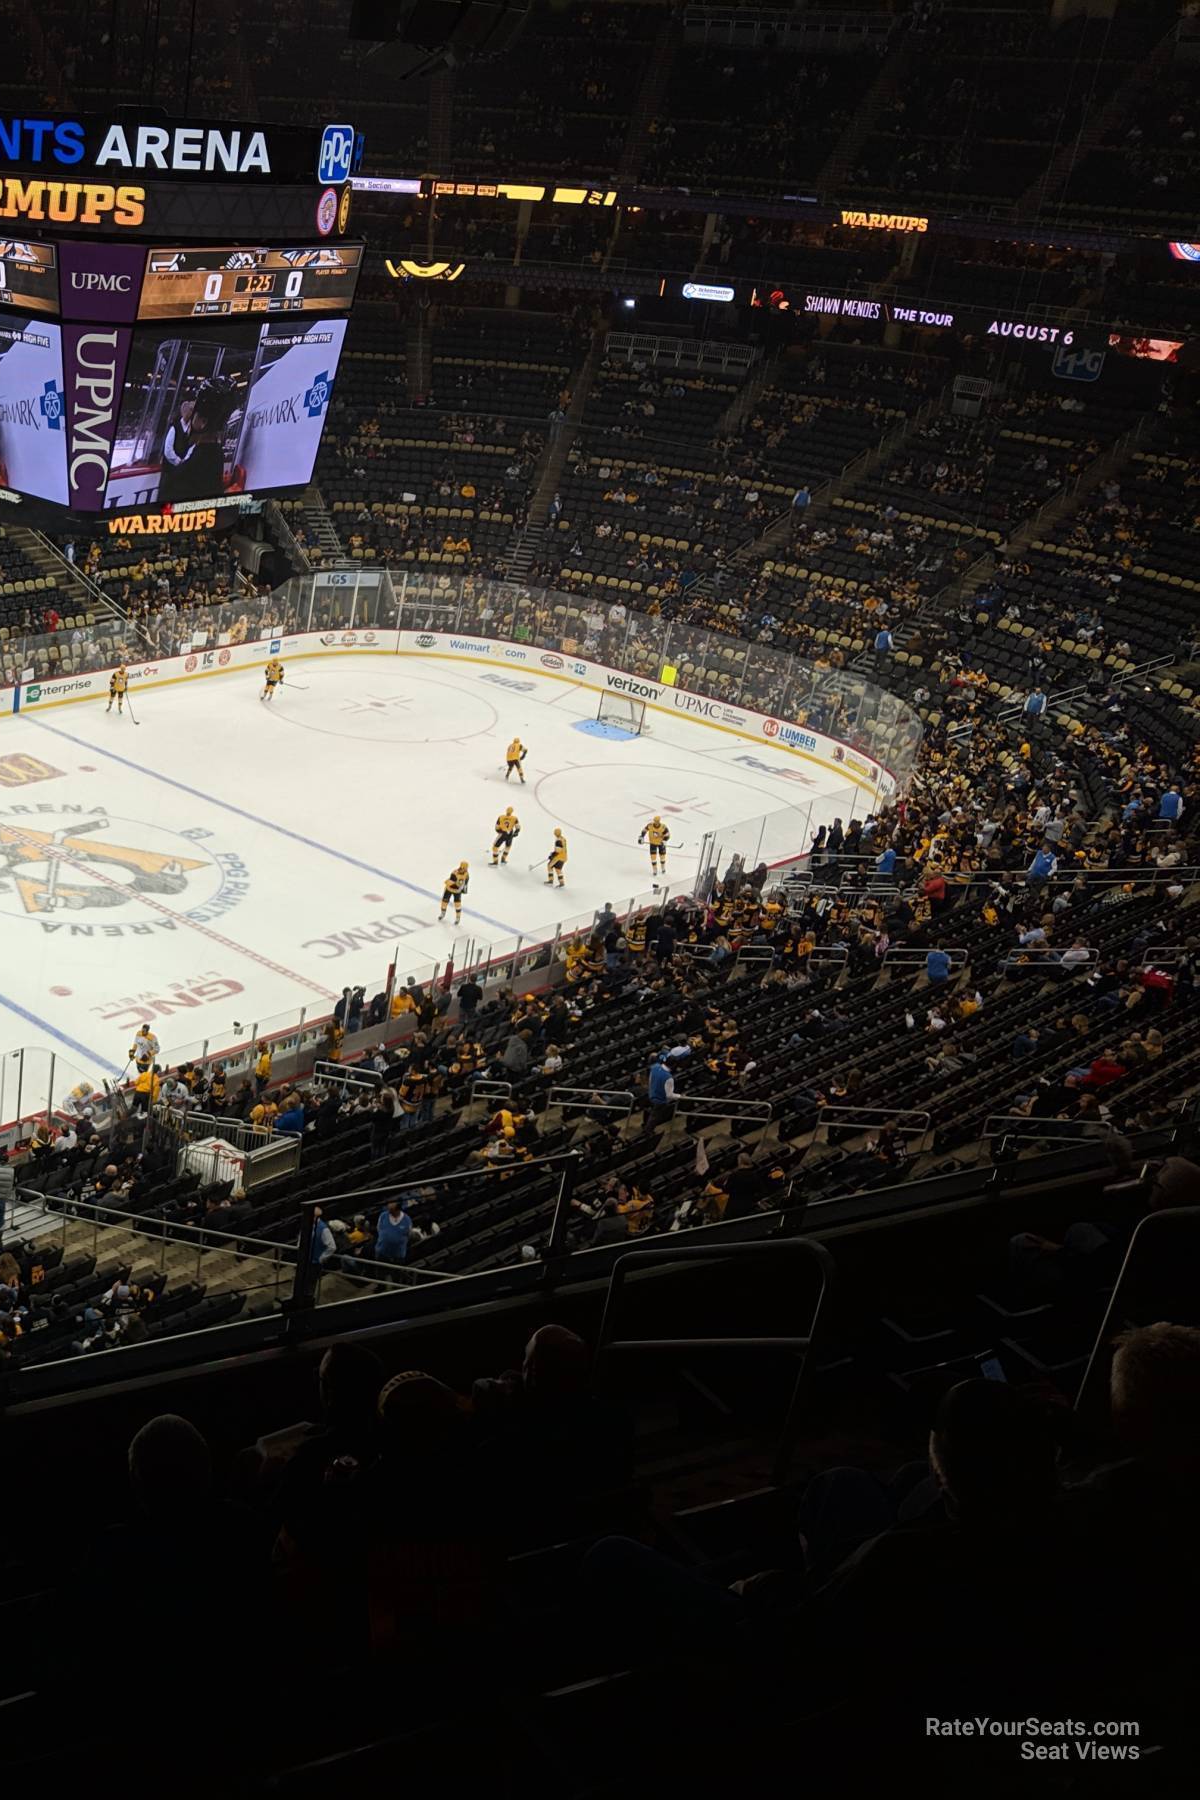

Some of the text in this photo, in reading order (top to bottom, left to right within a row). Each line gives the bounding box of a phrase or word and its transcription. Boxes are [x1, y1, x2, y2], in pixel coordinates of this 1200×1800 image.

[95, 125, 271, 173] ARENA
[321, 132, 351, 177] PPG
[841, 210, 929, 232] WARMUPS
[71, 271, 131, 293] UPMC
[204, 273, 223, 301] 0
[244, 275, 271, 292] 1:25
[285, 271, 303, 297] 0
[804, 295, 954, 327] SHAWN MENDES THE TOUR
[986, 320, 1075, 345] AUGUST 6
[69, 329, 118, 493] UPMC
[108, 509, 216, 535] WARMUPS
[327, 574, 347, 585] IGS
[450, 639, 490, 653] Walmart
[505, 647, 526, 659] com
[29, 679, 92, 699] enterprise
[607, 674, 659, 700] verizon
[675, 692, 722, 719] UPMC
[780, 726, 817, 748] LUMBER
[41, 919, 178, 937] ARENA
[301, 914, 435, 959] UPMC
[101, 979, 245, 1030] GNC
